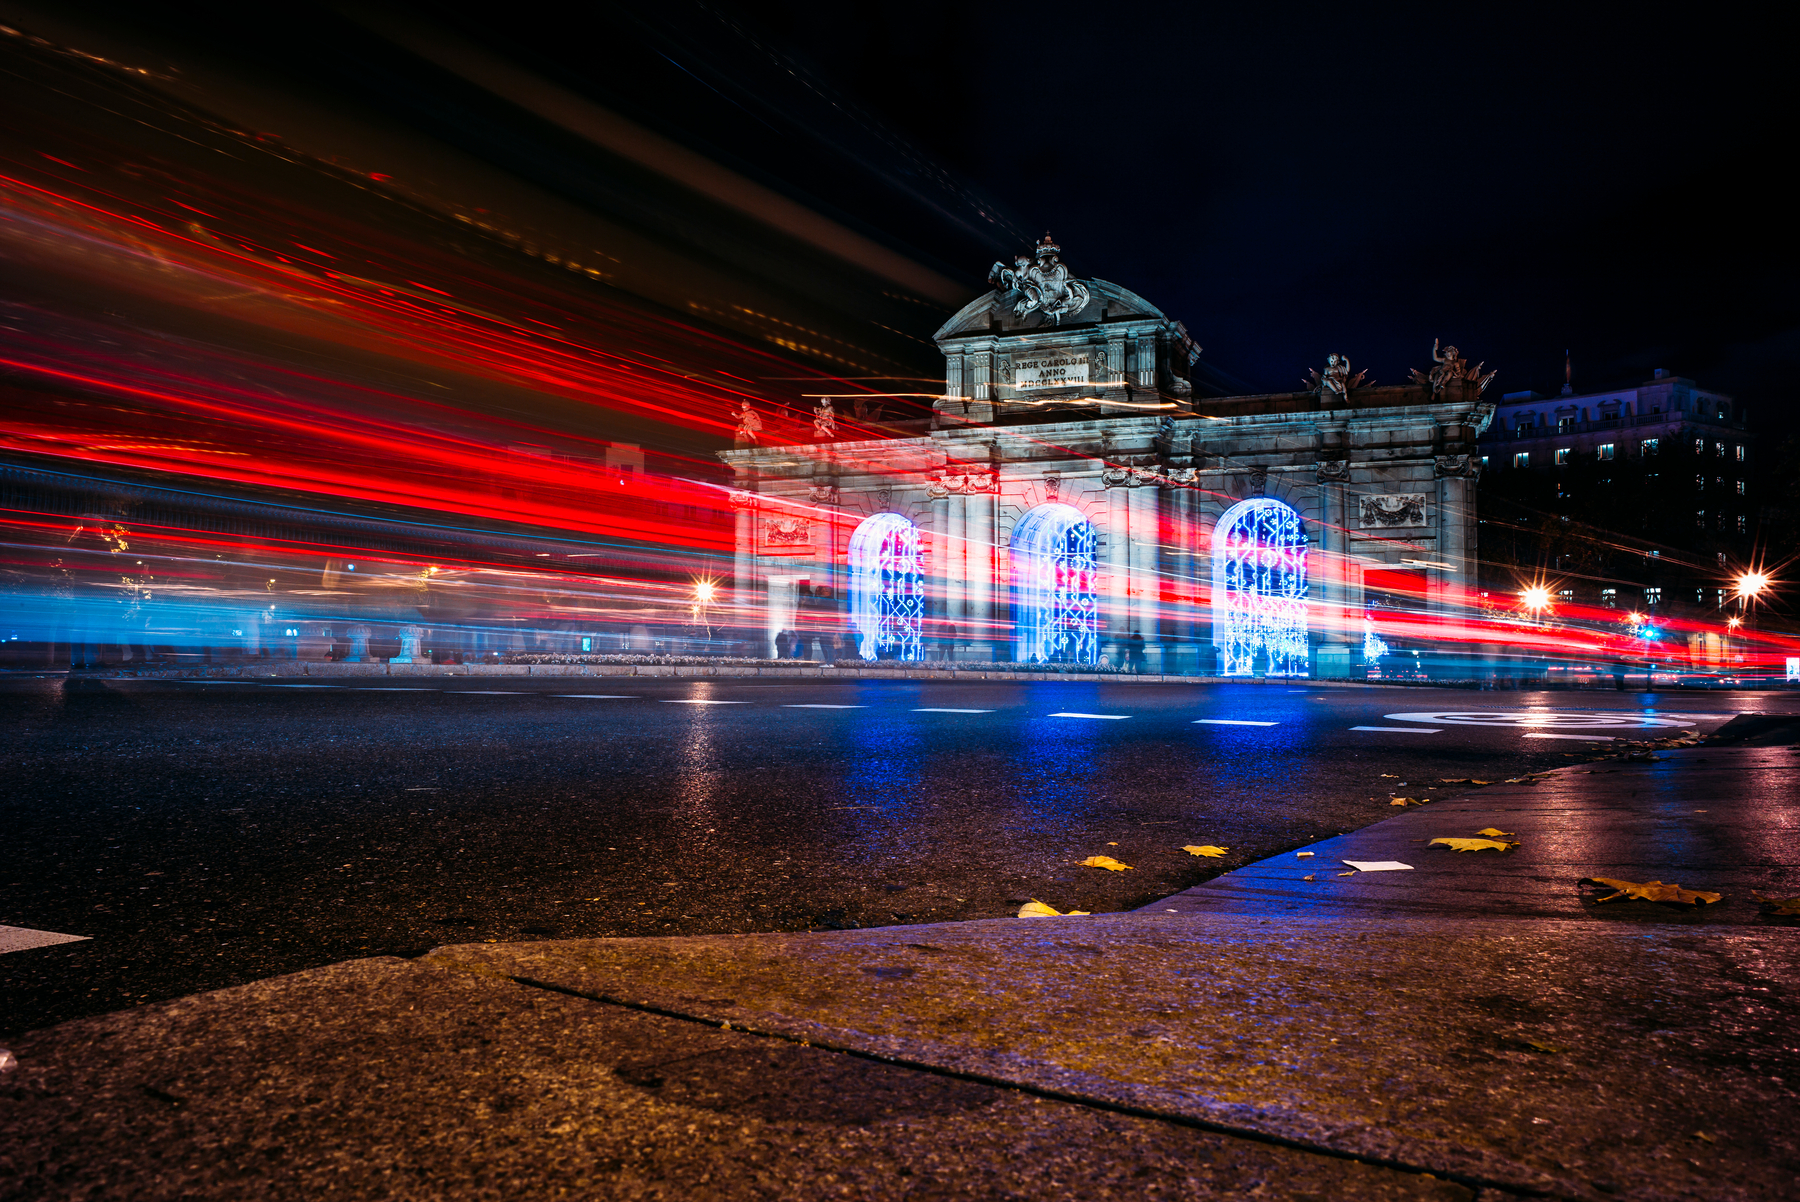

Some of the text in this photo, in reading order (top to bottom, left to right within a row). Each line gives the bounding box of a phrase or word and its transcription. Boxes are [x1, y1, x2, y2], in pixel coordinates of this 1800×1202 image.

[1016, 361, 1039, 370] REGE
[1041, 358, 1077, 367] CAROLO
[1039, 368, 1066, 378] ANNO
